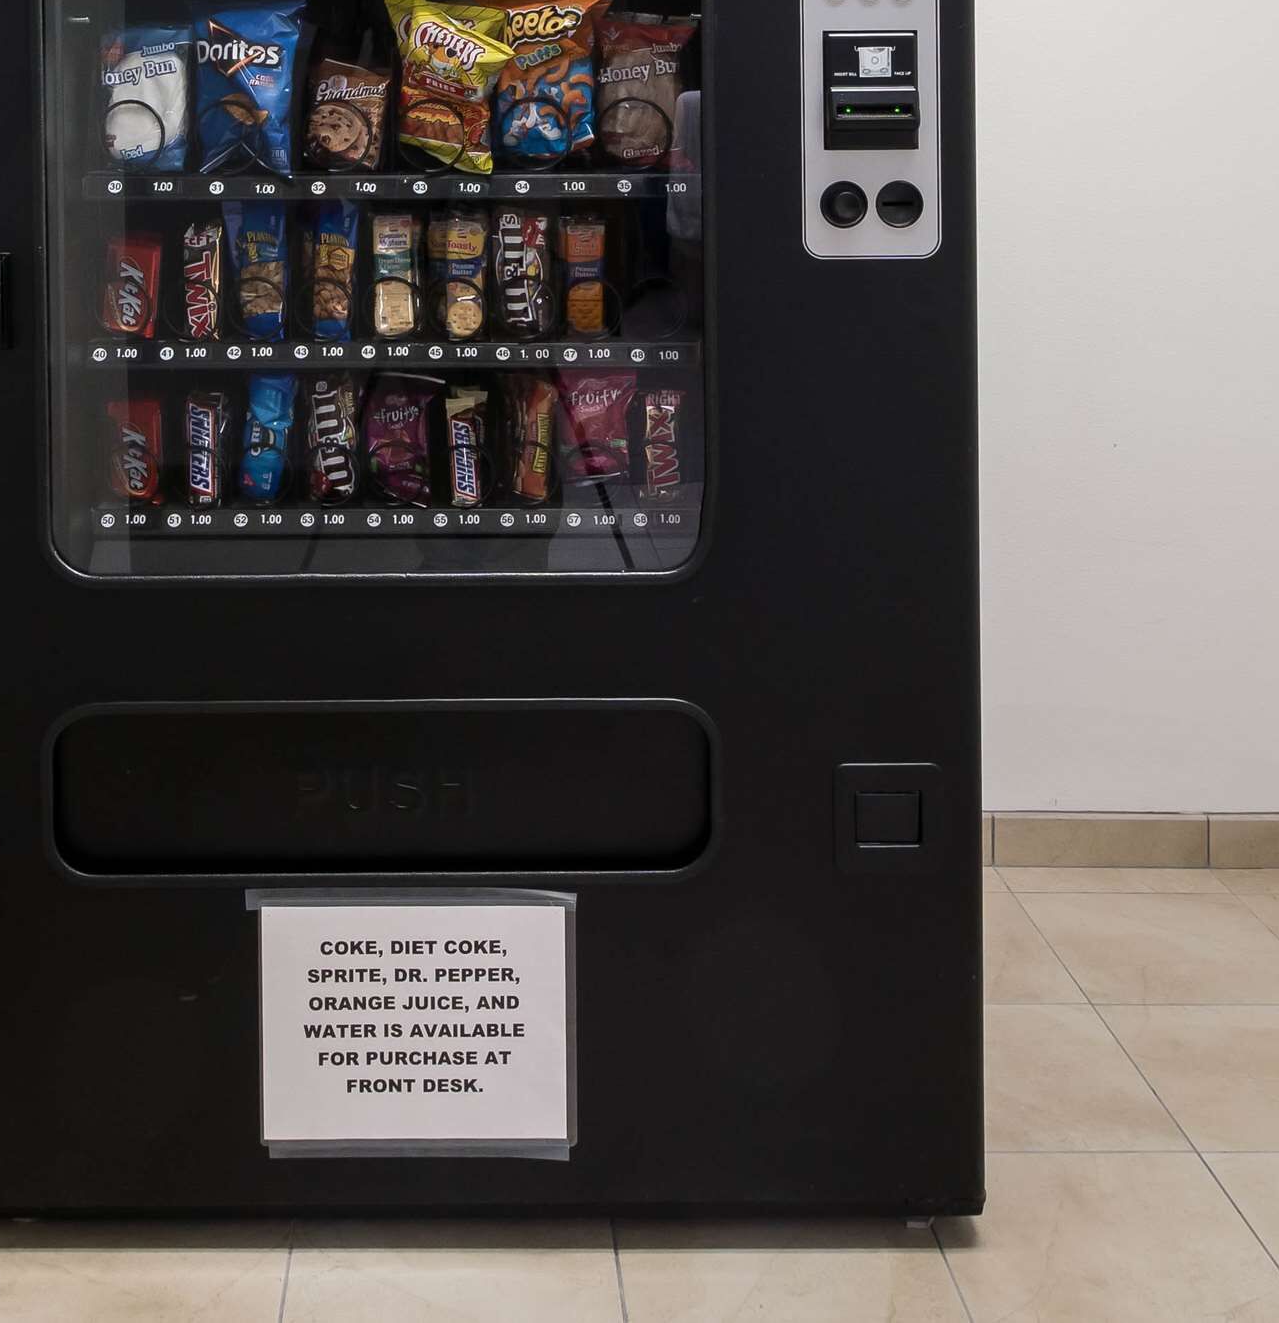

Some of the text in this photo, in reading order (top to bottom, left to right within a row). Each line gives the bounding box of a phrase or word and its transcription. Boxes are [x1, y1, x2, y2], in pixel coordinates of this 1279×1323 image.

[140, 41, 175, 58] Jumbo
[196, 40, 282, 66] Doritos
[515, 44, 562, 70] Puffs
[144, 59, 177, 78] Bun
[599, 64, 650, 85] Honey
[316, 79, 390, 102] Grandma's
[152, 181, 174, 192] 1.00
[255, 183, 276, 194] 1.00
[355, 182, 377, 193] 1.00
[458, 182, 481, 193] 1.00
[562, 181, 586, 191] 1.00
[664, 183, 687, 193] 1.00
[116, 348, 137, 358] 1.00
[185, 348, 207, 358] 1.00
[251, 347, 273, 357] 1.00
[322, 346, 344, 357] 1.00
[387, 346, 409, 357] 1.00
[456, 347, 478, 357] 1.00
[588, 348, 611, 359] 1.00
[125, 514, 147, 525] 1.00
[190, 514, 212, 525] 1.00
[261, 514, 282, 525] 1.00
[324, 514, 345, 524] 1.00
[392, 514, 414, 525] 1.00
[459, 514, 480, 525] 1.00
[525, 513, 547, 524] 1.00
[593, 515, 616, 525] 1.00
[660, 513, 681, 524] 1.00
[319, 940, 508, 957] COKE, DIET COKE,
[307, 967, 521, 985] SPRITE, DR. PEPPER,
[308, 995, 520, 1013] ORANGE JUICE, AND
[303, 1023, 525, 1038] WATER IS AVAILABLE
[318, 1051, 511, 1066] FOR PURCHASE AT
[346, 1078, 484, 1093] FRONT DESK.
